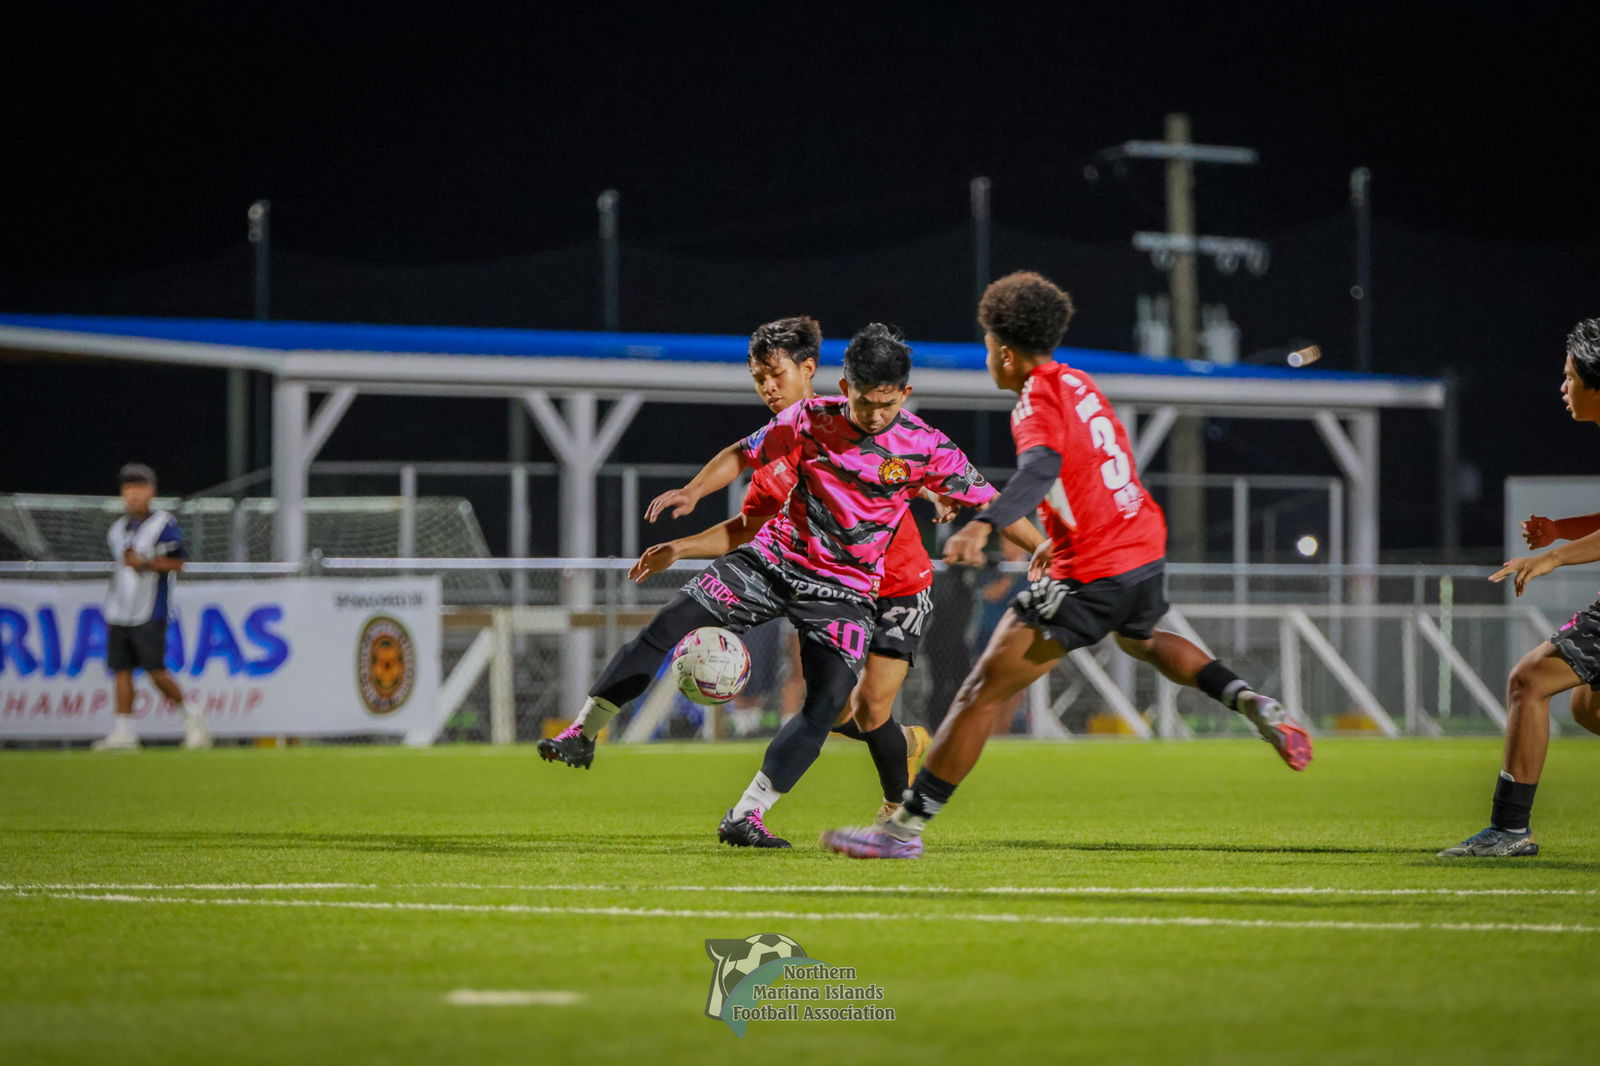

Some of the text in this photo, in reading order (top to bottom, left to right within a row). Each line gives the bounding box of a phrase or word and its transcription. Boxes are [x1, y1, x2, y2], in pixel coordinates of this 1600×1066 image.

[1090, 416, 1131, 490] 3
[697, 573, 741, 609] TRIBE
[825, 621, 866, 660] 10
